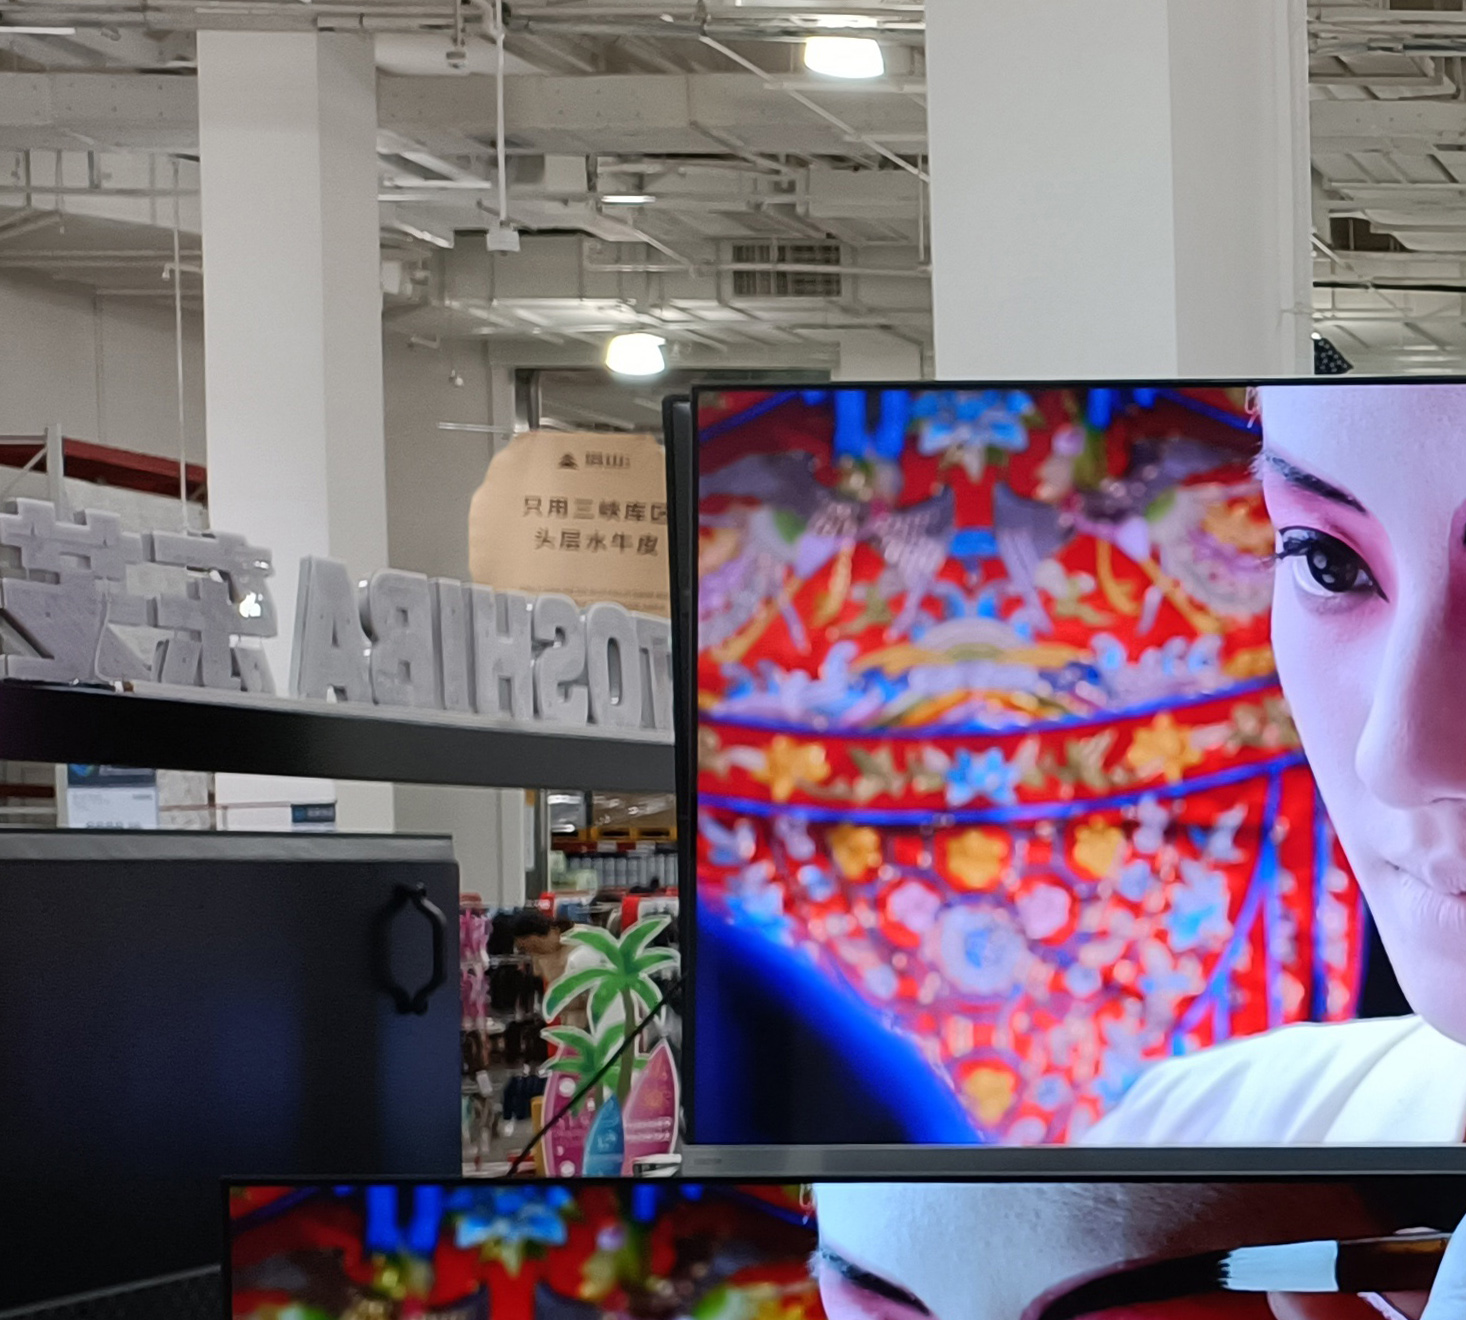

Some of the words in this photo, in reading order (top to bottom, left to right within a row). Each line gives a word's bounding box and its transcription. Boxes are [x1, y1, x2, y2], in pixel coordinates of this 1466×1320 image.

[534, 527, 659, 557] 头层水牛皮
